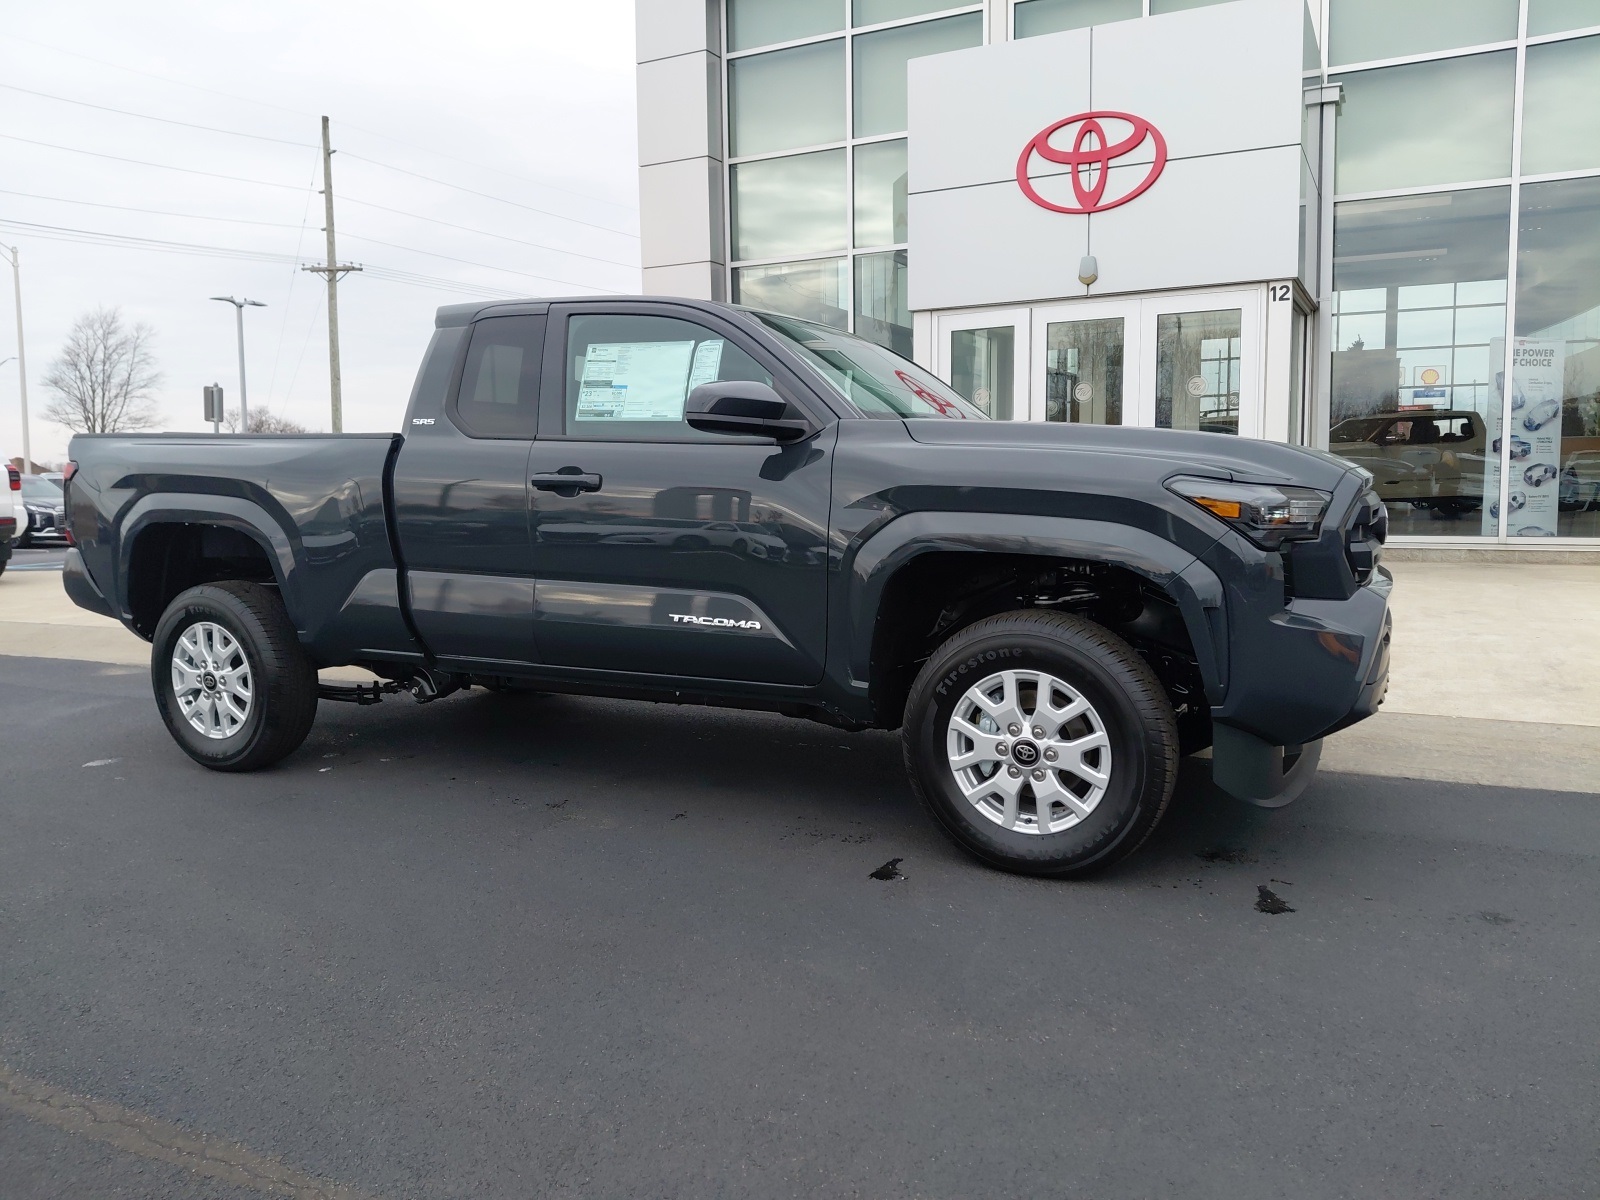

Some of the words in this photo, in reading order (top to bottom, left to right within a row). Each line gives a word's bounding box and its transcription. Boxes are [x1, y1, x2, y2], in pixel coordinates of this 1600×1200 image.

[1270, 285, 1290, 301] 12
[1523, 348, 1555, 357] POWER
[1520, 358, 1552, 367] CHOICE
[668, 614, 761, 630] TACOMA
[935, 647, 1022, 696] Firestone
